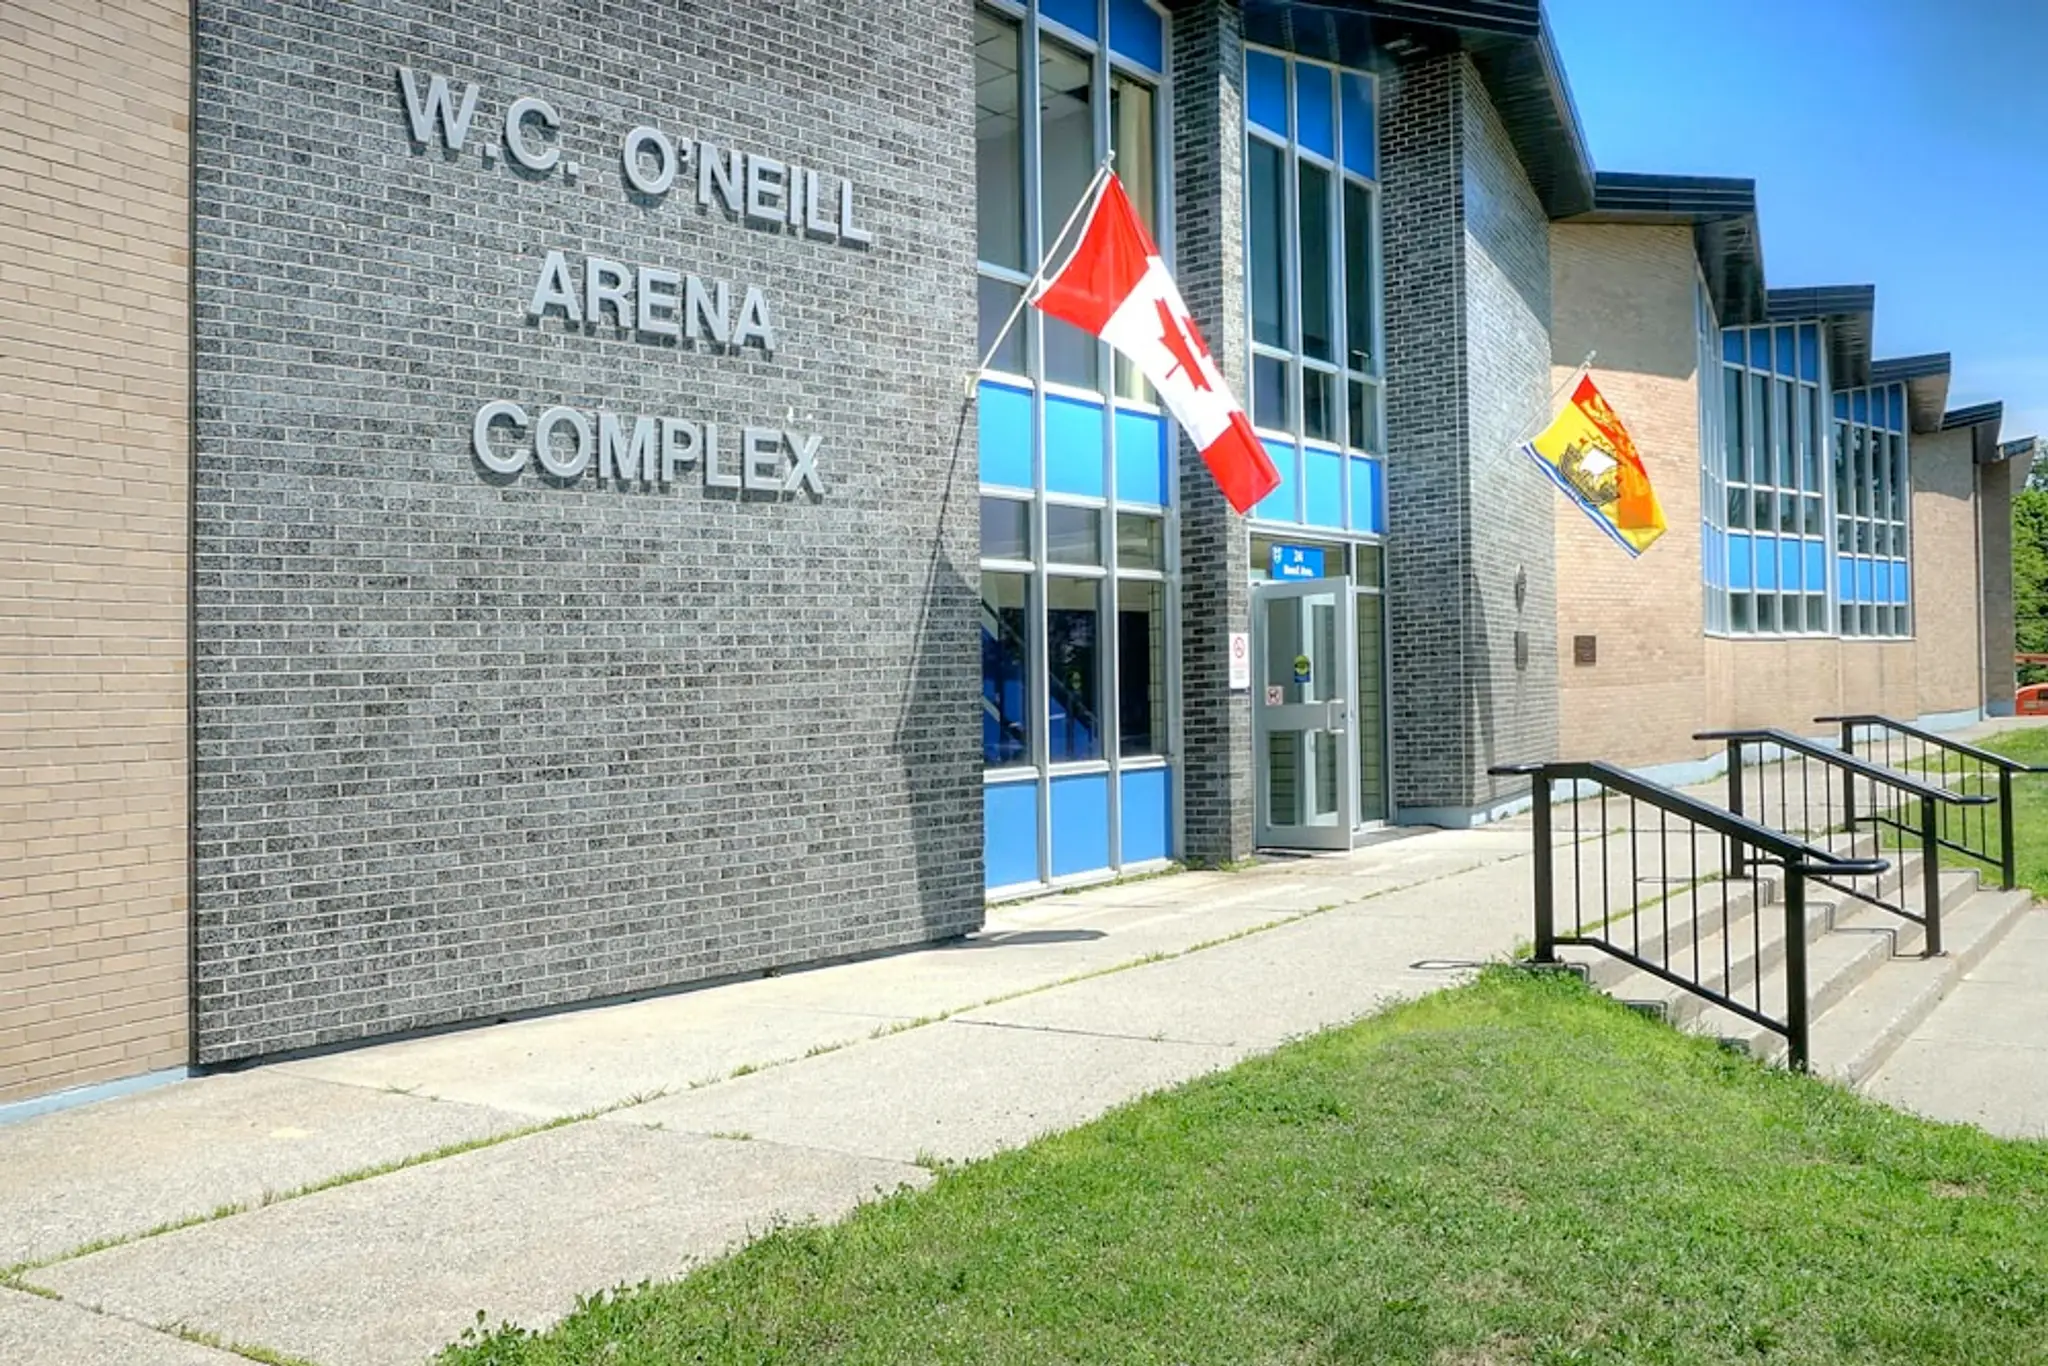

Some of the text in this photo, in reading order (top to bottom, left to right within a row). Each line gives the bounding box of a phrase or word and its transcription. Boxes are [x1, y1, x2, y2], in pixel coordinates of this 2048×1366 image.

[399, 68, 873, 243] W.C. O'NEILL
[528, 250, 775, 351] ARENA
[472, 400, 826, 496] COMPLEX
